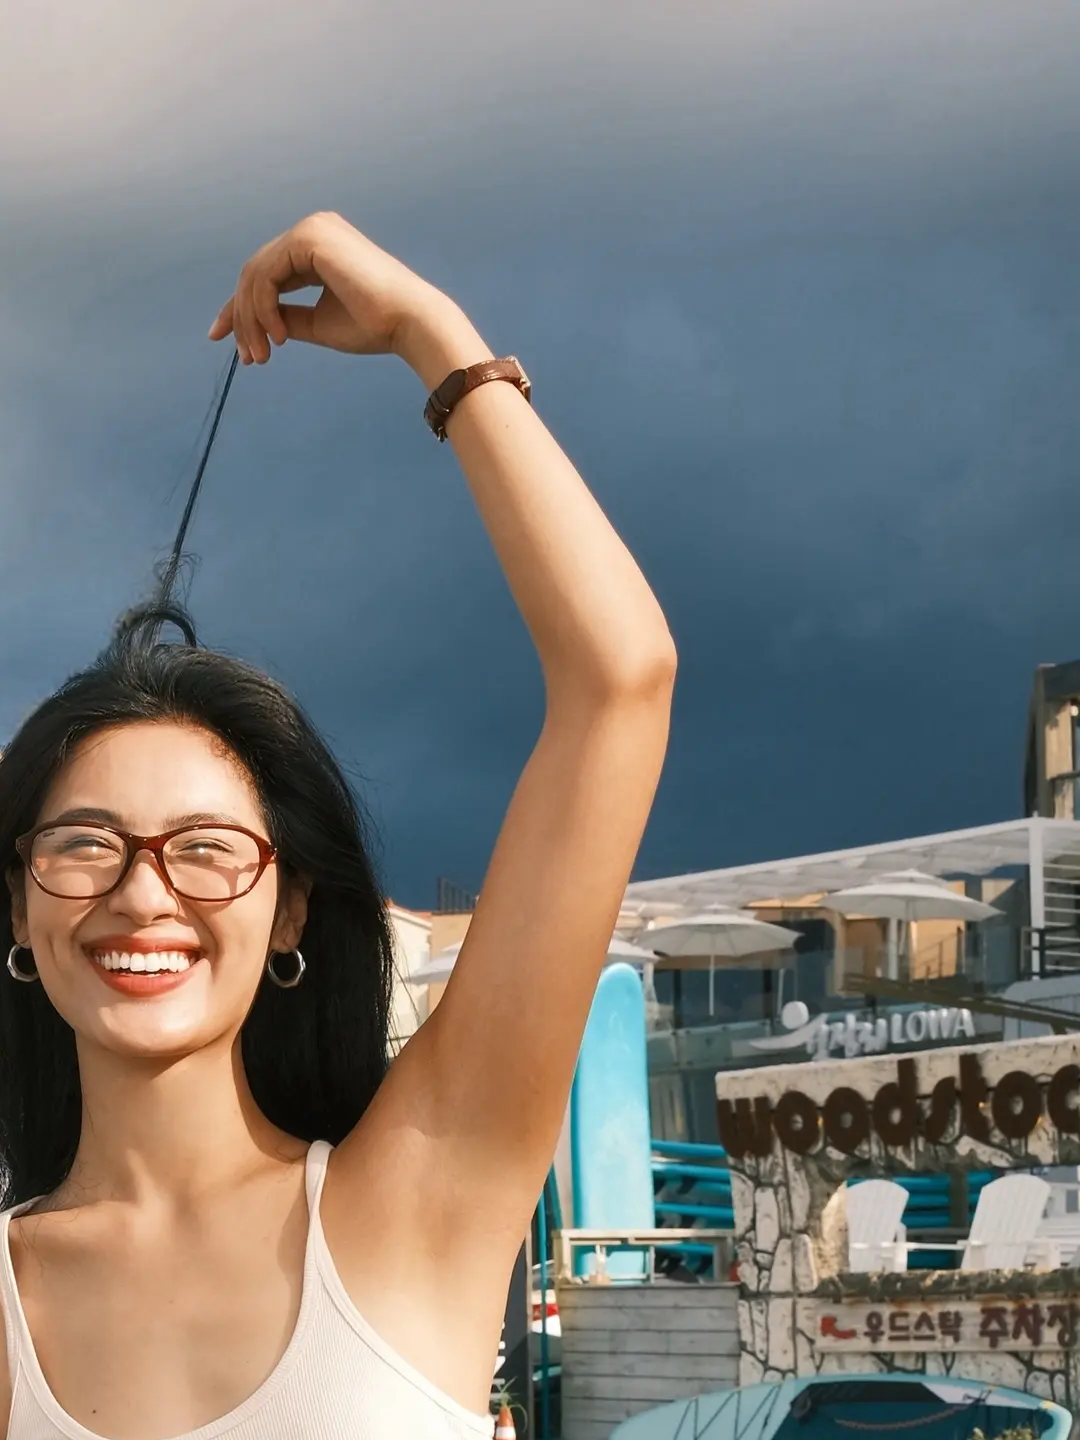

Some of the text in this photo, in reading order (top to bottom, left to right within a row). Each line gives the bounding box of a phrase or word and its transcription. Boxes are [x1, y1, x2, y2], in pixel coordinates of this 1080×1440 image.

[891, 1007, 976, 1044] LOWA
[863, 1303, 1079, 1349] 우드스탁 주차장
